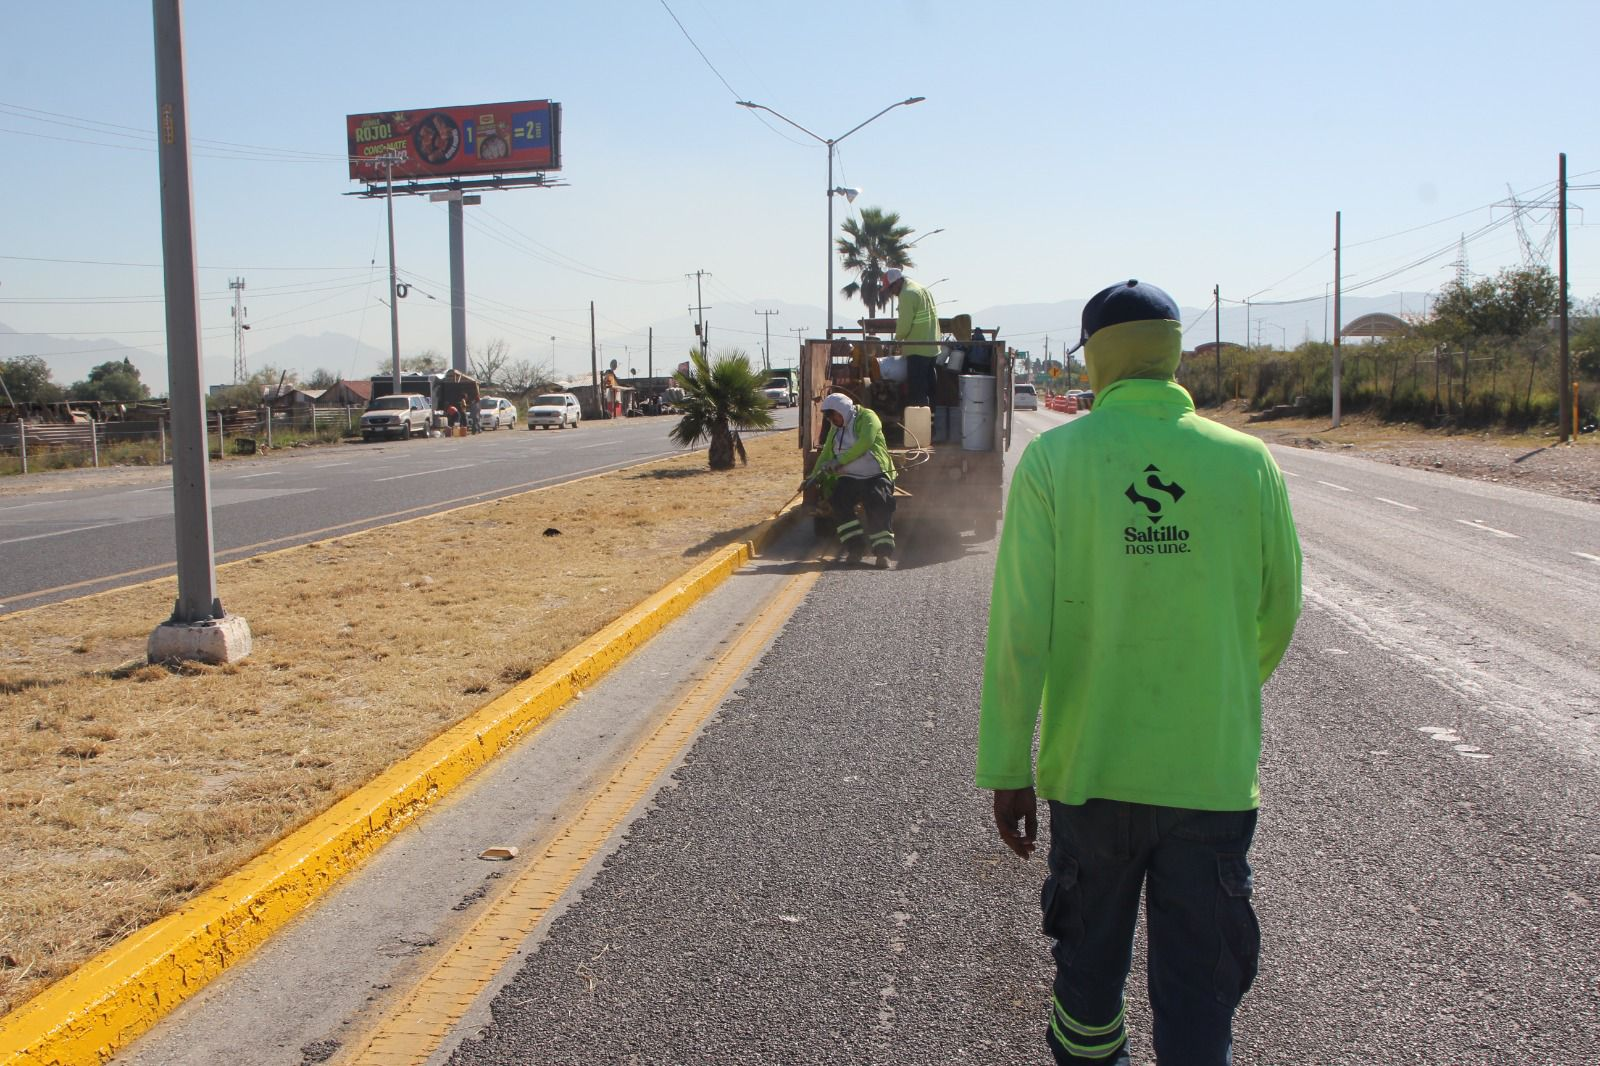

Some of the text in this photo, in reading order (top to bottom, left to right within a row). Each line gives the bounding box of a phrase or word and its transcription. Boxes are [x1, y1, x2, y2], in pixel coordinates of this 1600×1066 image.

[355, 123, 392, 143] ROJO!
[466, 127, 473, 144] 1
[1124, 525, 1190, 542] Saltillo
[1125, 542, 1191, 555] nos une.
